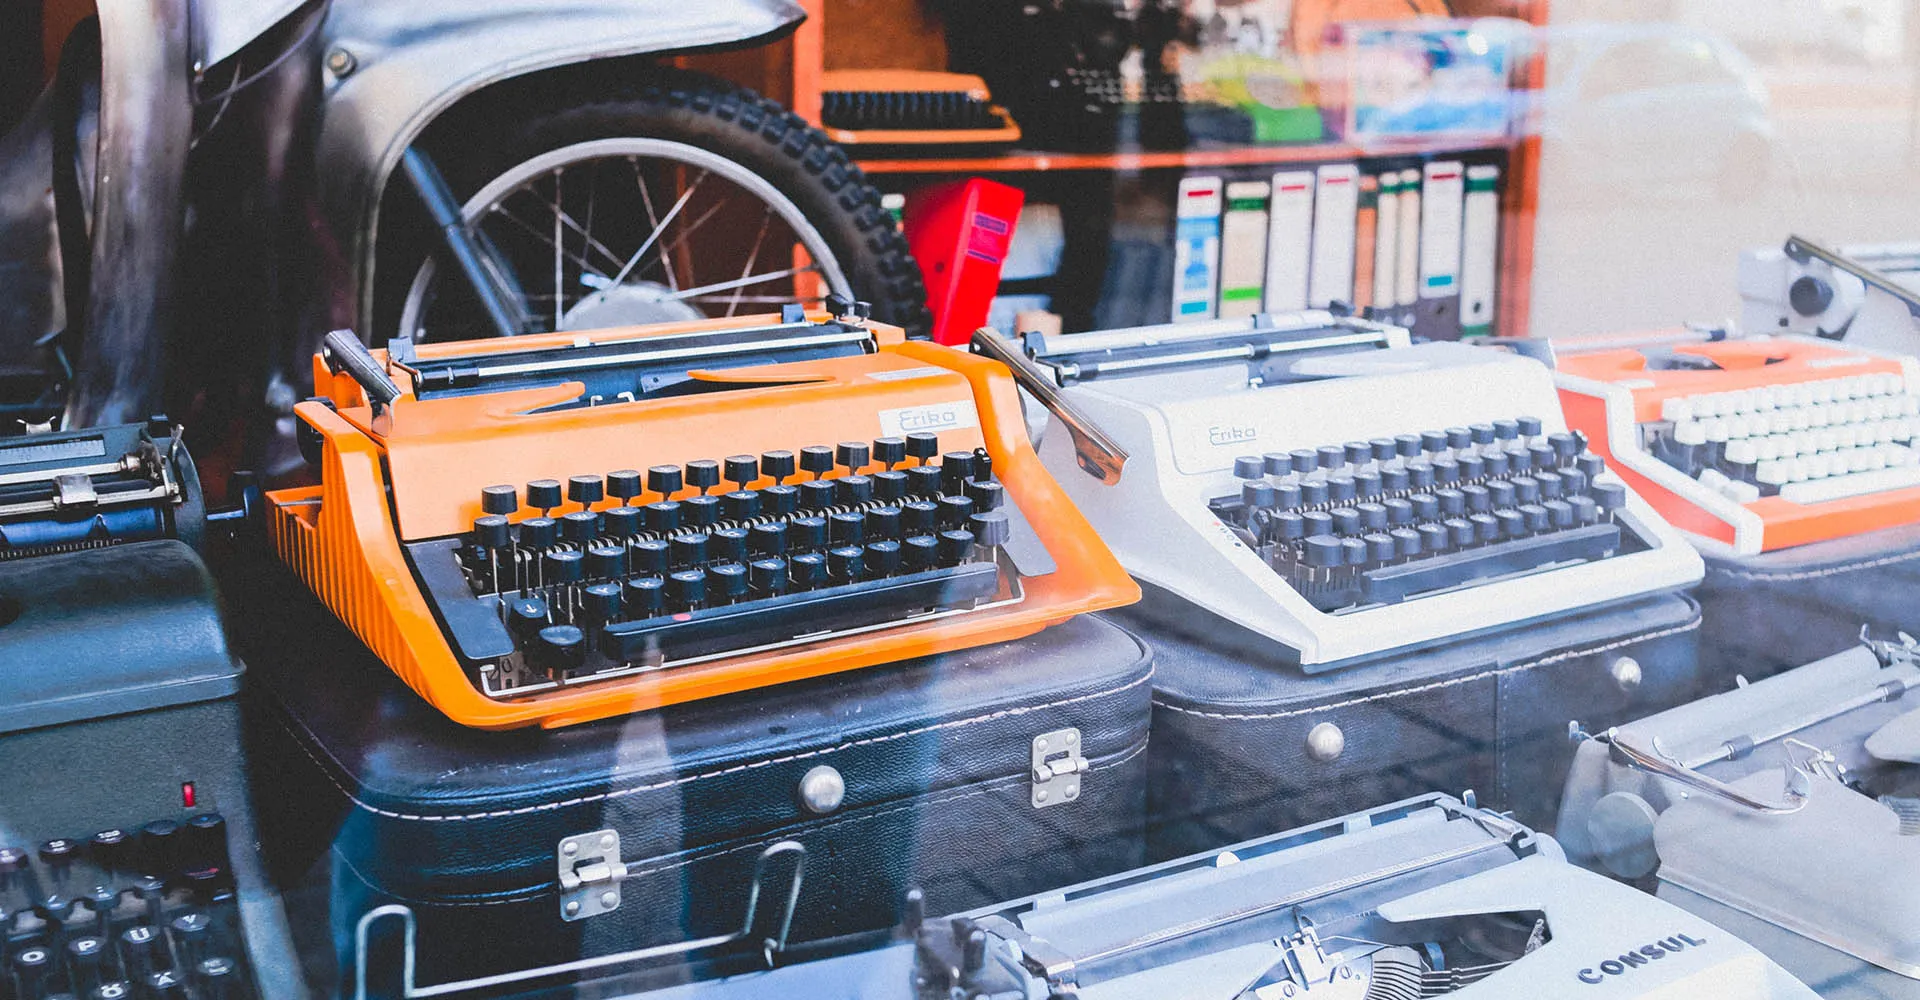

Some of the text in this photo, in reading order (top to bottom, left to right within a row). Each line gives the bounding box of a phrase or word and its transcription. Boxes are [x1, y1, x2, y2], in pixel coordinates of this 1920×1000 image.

[899, 410, 957, 432] Erika
[1209, 426, 1257, 446] Erika
[78, 940, 97, 952] P
[1578, 933, 1707, 985] CONSUL
